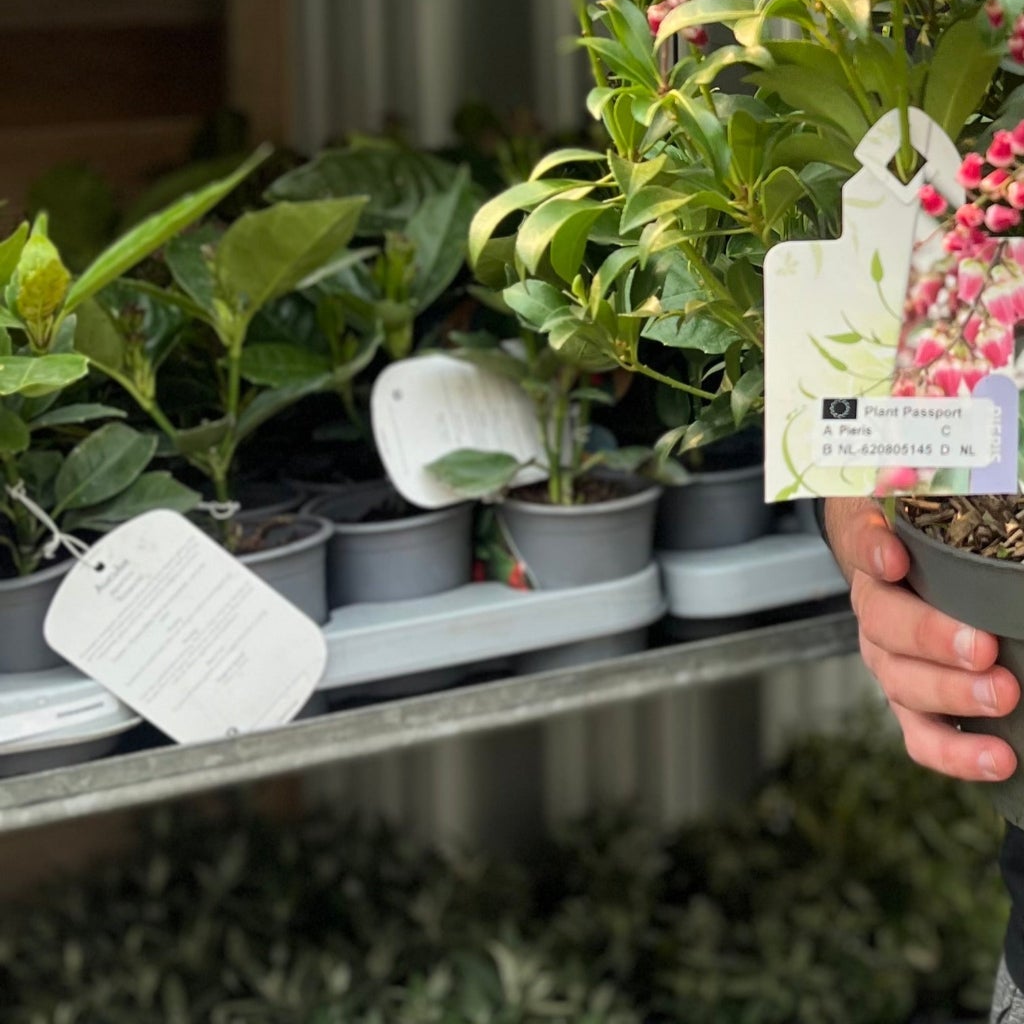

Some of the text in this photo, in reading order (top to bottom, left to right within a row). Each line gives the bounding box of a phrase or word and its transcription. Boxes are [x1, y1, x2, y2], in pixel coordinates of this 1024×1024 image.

[864, 406, 963, 420] Plant Passport
[822, 424, 952, 437] A Pieris C
[822, 444, 833, 456] B
[939, 444, 951, 456] D
[959, 444, 977, 456] NL
